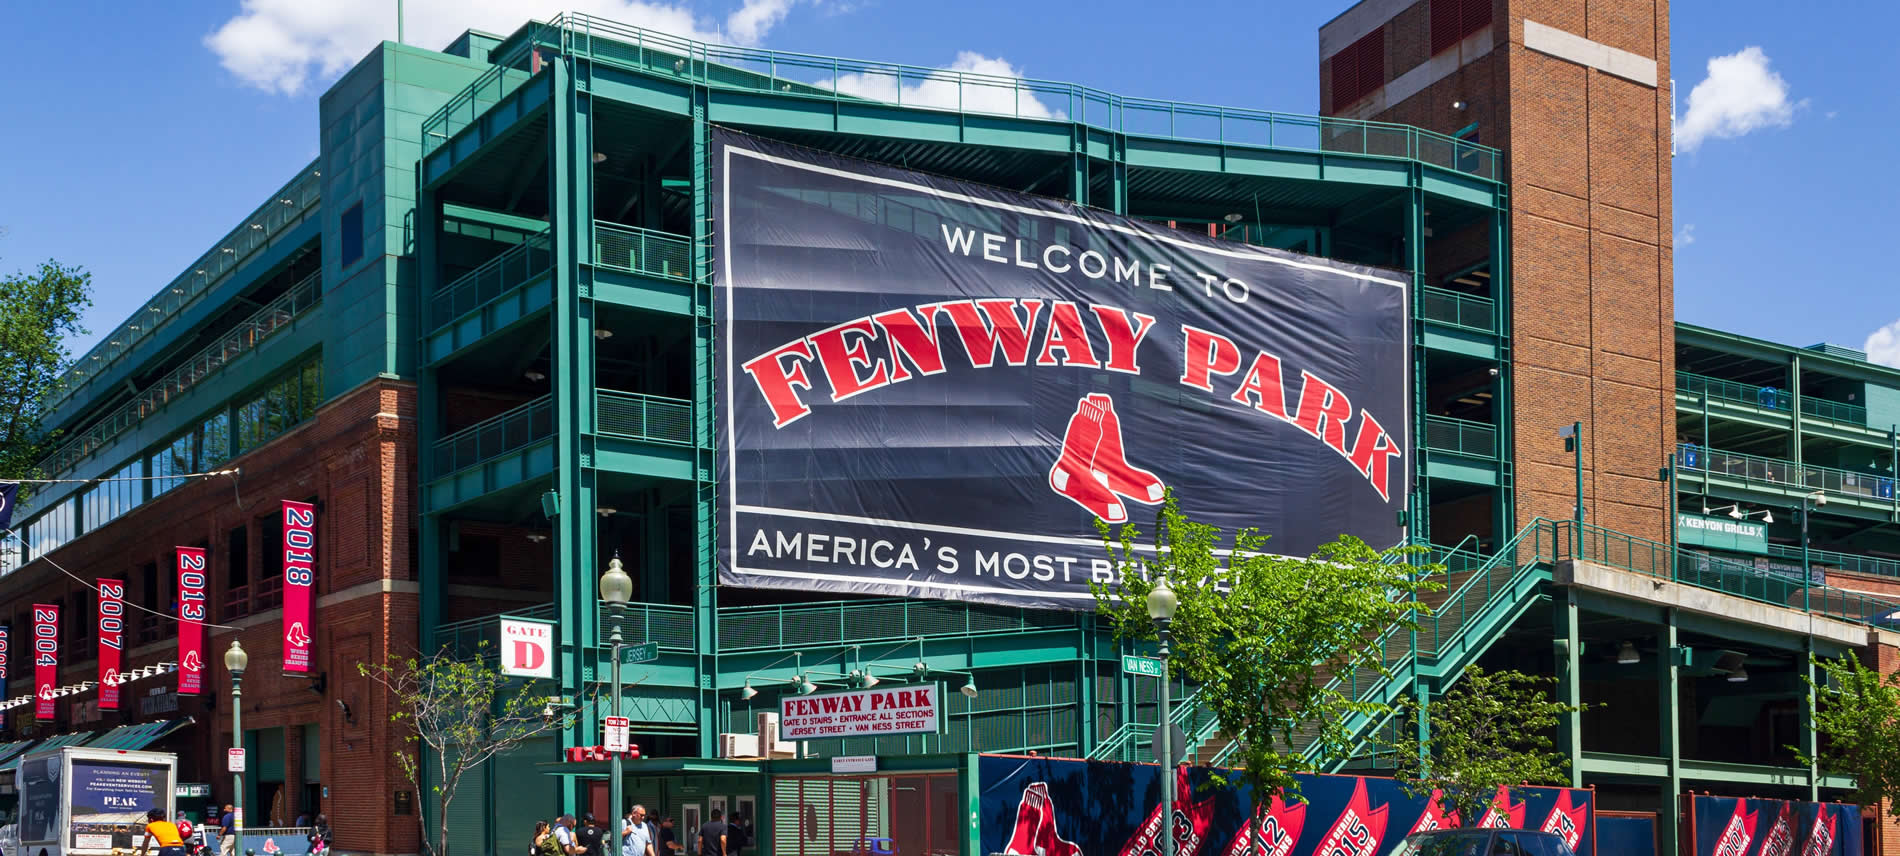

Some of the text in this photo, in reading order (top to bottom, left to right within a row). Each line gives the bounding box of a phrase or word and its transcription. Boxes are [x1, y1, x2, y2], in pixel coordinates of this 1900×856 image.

[940, 222, 1251, 304] WELCOME TO
[741, 297, 1403, 503] FENWAY PARK
[1686, 517, 1755, 537] KENYON GRILLS
[286, 507, 314, 587] 2018
[747, 528, 960, 574] AMERICA'S
[974, 549, 1078, 584] MOST
[181, 554, 206, 621] 2013
[101, 583, 123, 650] 2007
[506, 625, 547, 638] GATE
[35, 609, 57, 666] 2004
[512, 640, 545, 670] D
[625, 647, 647, 663] JERSEY
[1126, 658, 1138, 671] VAN
[1139, 660, 1154, 674] NESS
[784, 689, 931, 717] FENWAY PARK
[784, 718, 800, 727] GATE
[809, 716, 833, 725] STAIRS
[839, 713, 877, 723] ENTRANCE
[879, 712, 893, 720] ALL
[895, 709, 934, 719] SECTIONS
[790, 720, 926, 736] JERSEY STREET VAN NESS STREET
[103, 796, 138, 807] PEAK
[1331, 815, 1370, 856] 15
[1333, 808, 1355, 840] SERIES
[1723, 816, 1746, 856] 007
[1768, 820, 1791, 856] 013
[1811, 822, 1830, 856] 018
